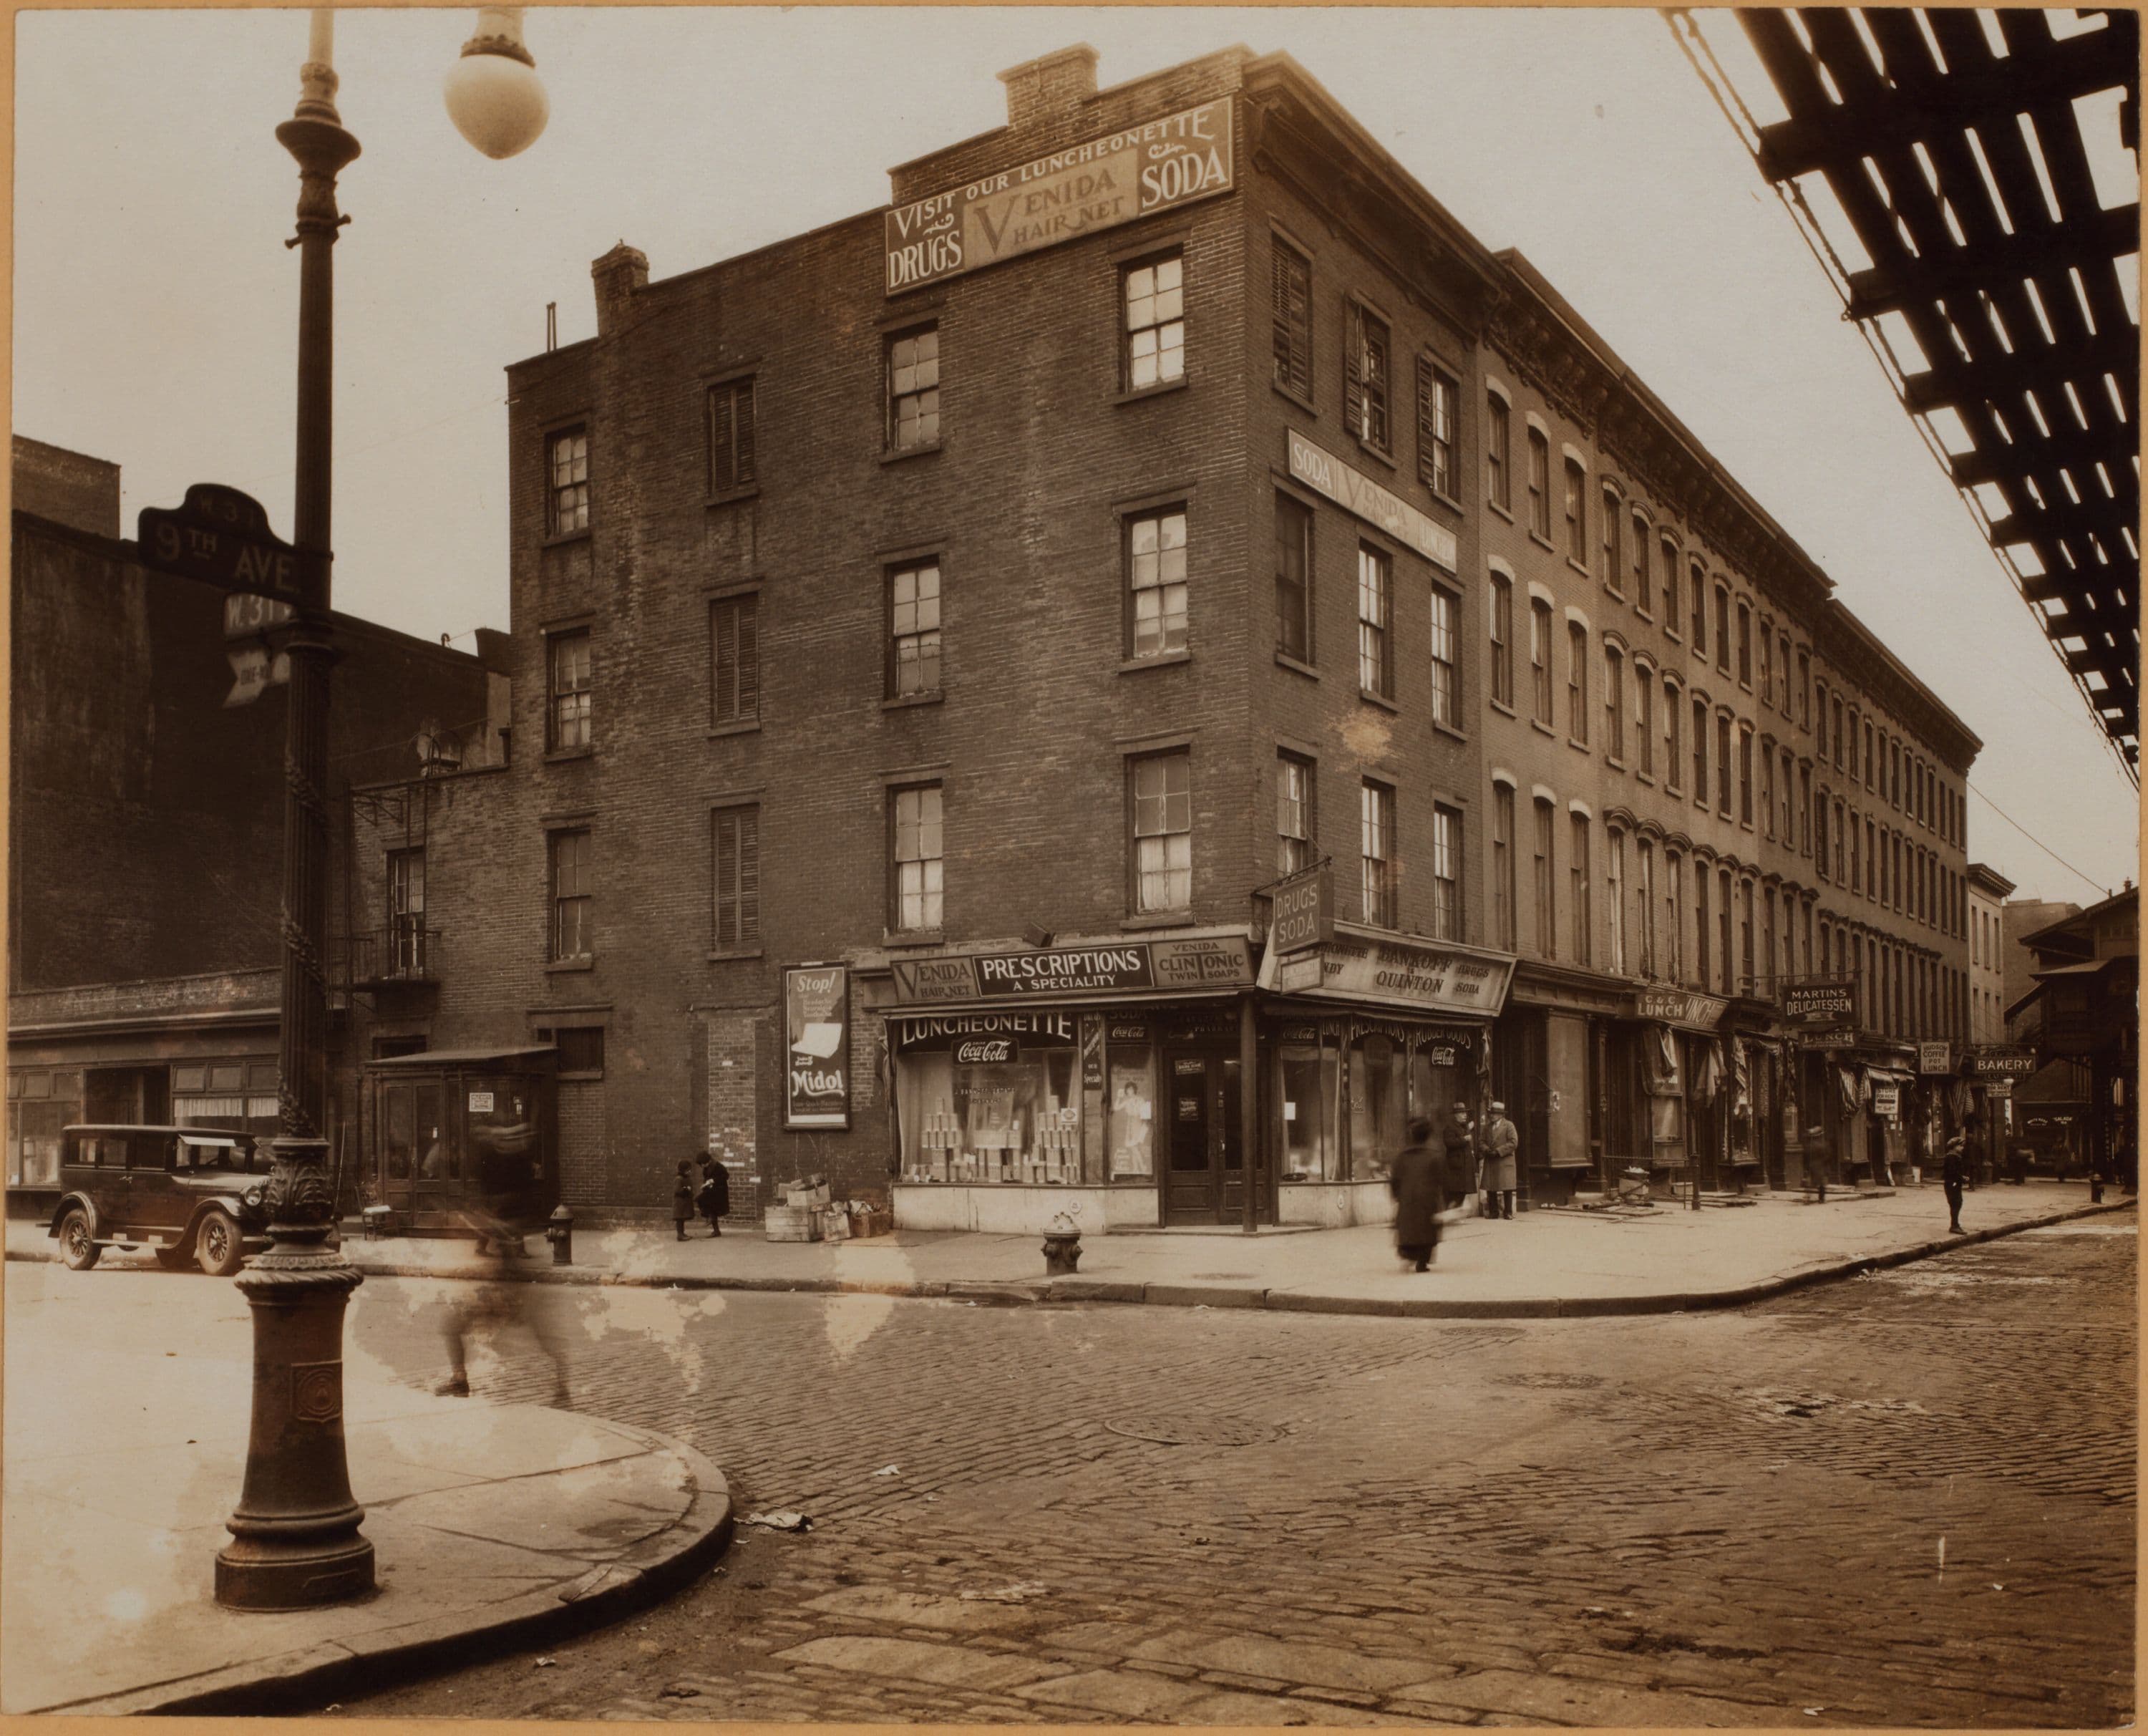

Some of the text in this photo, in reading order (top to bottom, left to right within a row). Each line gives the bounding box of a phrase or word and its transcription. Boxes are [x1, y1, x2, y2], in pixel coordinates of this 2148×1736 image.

[895, 106, 1215, 238] VISIT OUR LUNCHEONETTE
[1141, 145, 1228, 207] SODA
[973, 168, 1117, 255] VENIDA
[1014, 195, 1125, 246] HAIR NET
[888, 230, 962, 287] DRUGS
[1293, 442, 1332, 490] SODA
[1276, 883, 1318, 919] DRUGS
[1278, 911, 1316, 944] SODA
[1172, 941, 1220, 952] VENIDA
[981, 950, 1141, 980] PRESCRIPTIONS
[1377, 946, 1452, 973] BANKOFF
[797, 971, 836, 994] Stop!
[895, 962, 971, 998] VENIDA
[1013, 974, 1116, 991] A SPECIALITY
[1168, 969, 1240, 981] TWIN SOAPS
[1376, 970, 1444, 993] QUINTON
[1456, 964, 1490, 979] DRUGS
[920, 984, 971, 998] HAIR NET
[1455, 982, 1479, 994] SODA
[1637, 1002, 1683, 1017] LUNCH
[1644, 995, 1653, 1004] C
[1668, 996, 1676, 1005] C
[1787, 998, 1852, 1016] DELICATESSEN
[903, 1012, 1071, 1046] LUNCHEONETTE
[1112, 1026, 1145, 1038] Coca-Cola
[958, 1040, 1012, 1062] Coca-Cola
[1978, 1059, 2032, 1071] BAKERY
[791, 1070, 845, 1097] Midol
